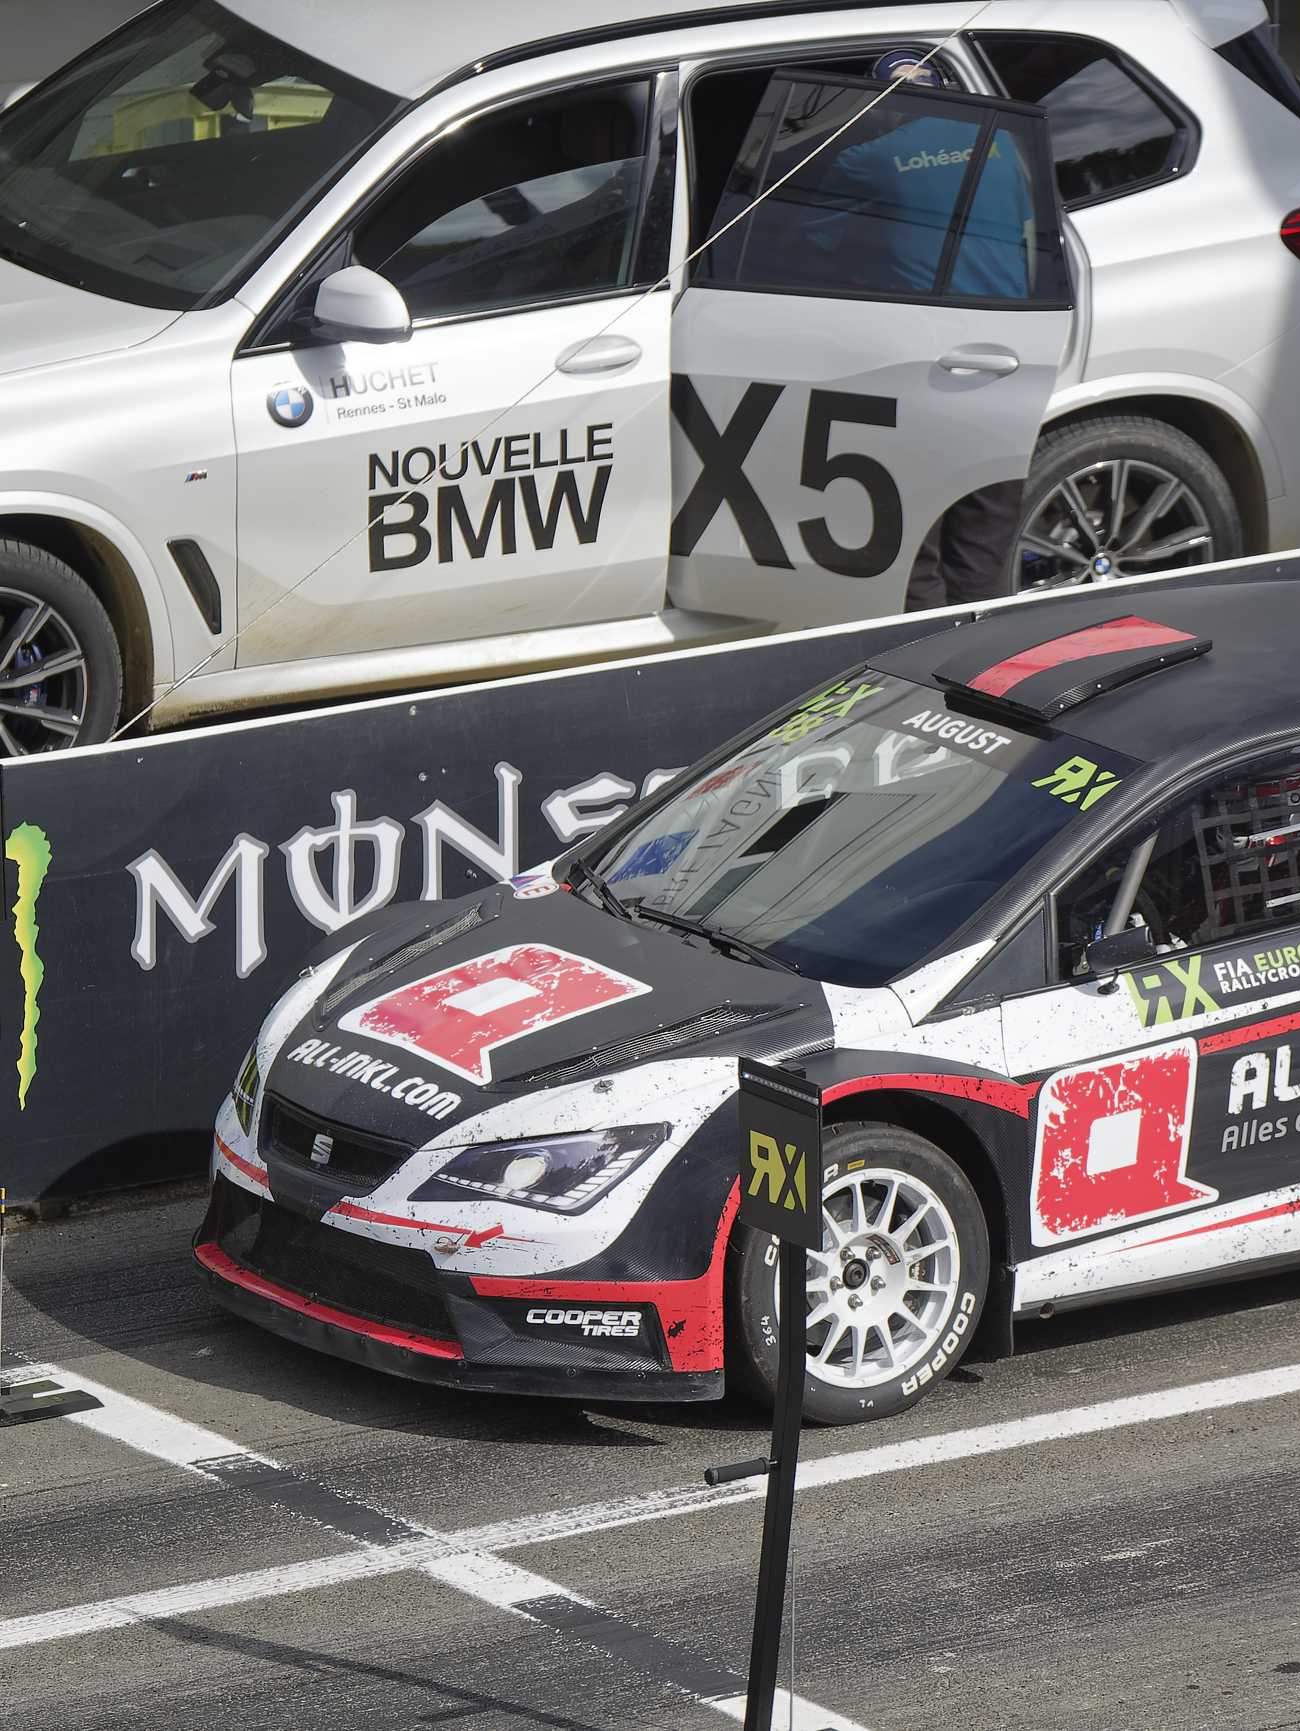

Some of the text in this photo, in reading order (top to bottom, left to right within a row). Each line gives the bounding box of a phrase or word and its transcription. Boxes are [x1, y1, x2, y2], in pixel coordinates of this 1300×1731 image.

[894, 148, 974, 172] Lohéac
[329, 362, 439, 399] HUCHET
[337, 404, 387, 420] Rennes
[397, 396, 412, 411] St
[415, 392, 447, 407] Malo
[368, 422, 614, 490] NOUVELLE
[669, 372, 904, 578] X5
[368, 464, 613, 573] BMW
[901, 710, 1012, 754] AUGUST
[1213, 958, 1253, 981] FIA
[1221, 1112, 1288, 1153] Alles
[526, 1308, 642, 1326] COOPER
[580, 1325, 640, 1337] TIRES
[902, 1291, 976, 1396] COOPER
